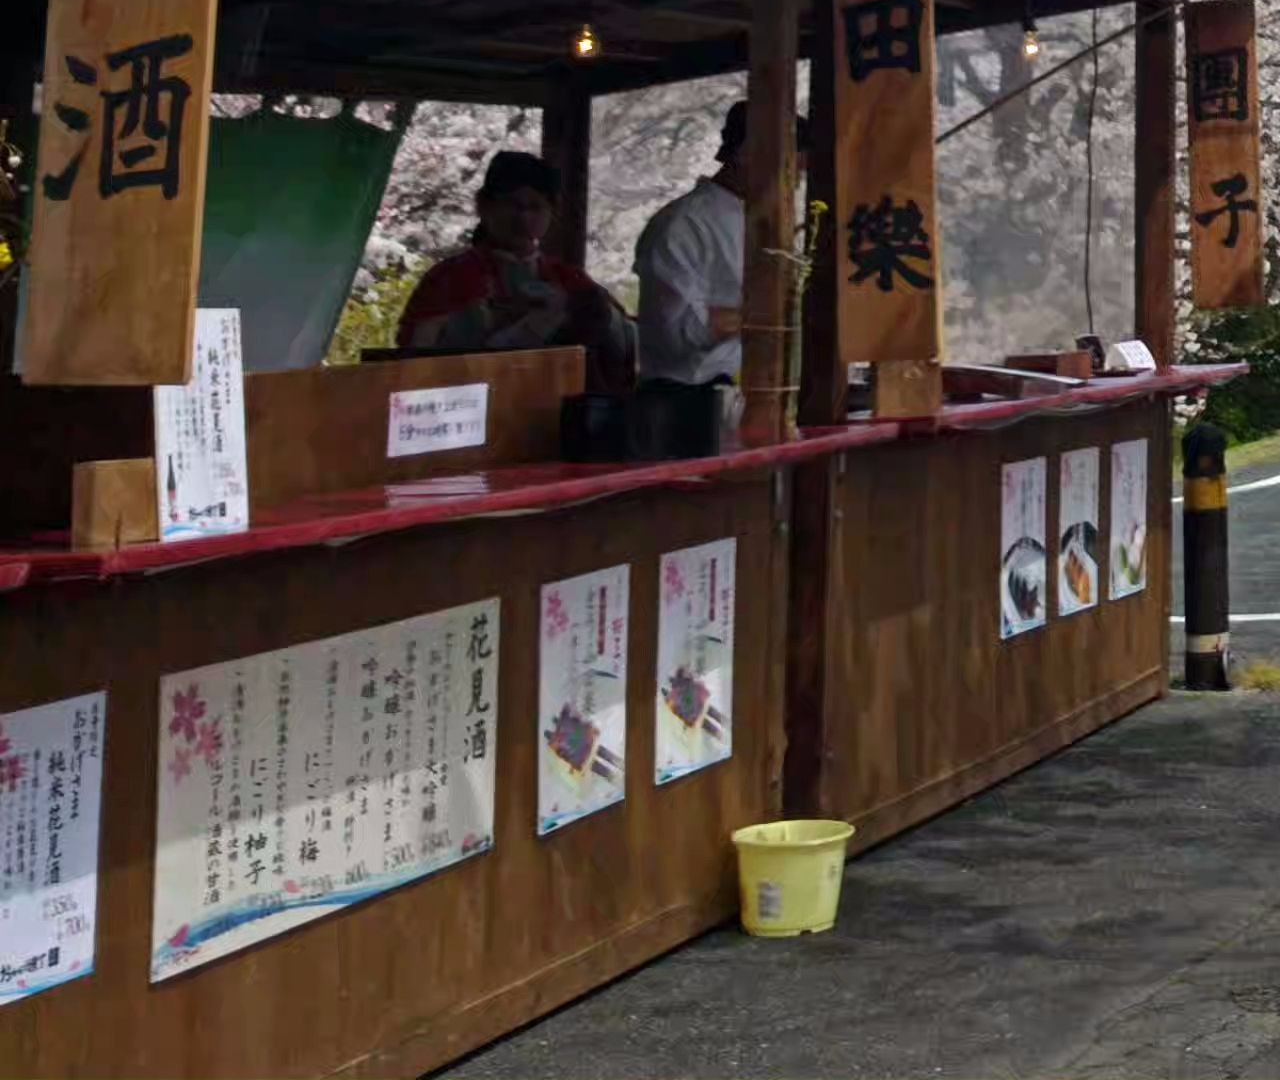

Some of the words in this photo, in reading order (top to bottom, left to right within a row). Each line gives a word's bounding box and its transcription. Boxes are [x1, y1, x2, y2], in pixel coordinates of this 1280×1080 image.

[463, 612, 493, 765] 花見酒
[244, 756, 269, 887] にごり柚子
[299, 751, 321, 867] にごり梅
